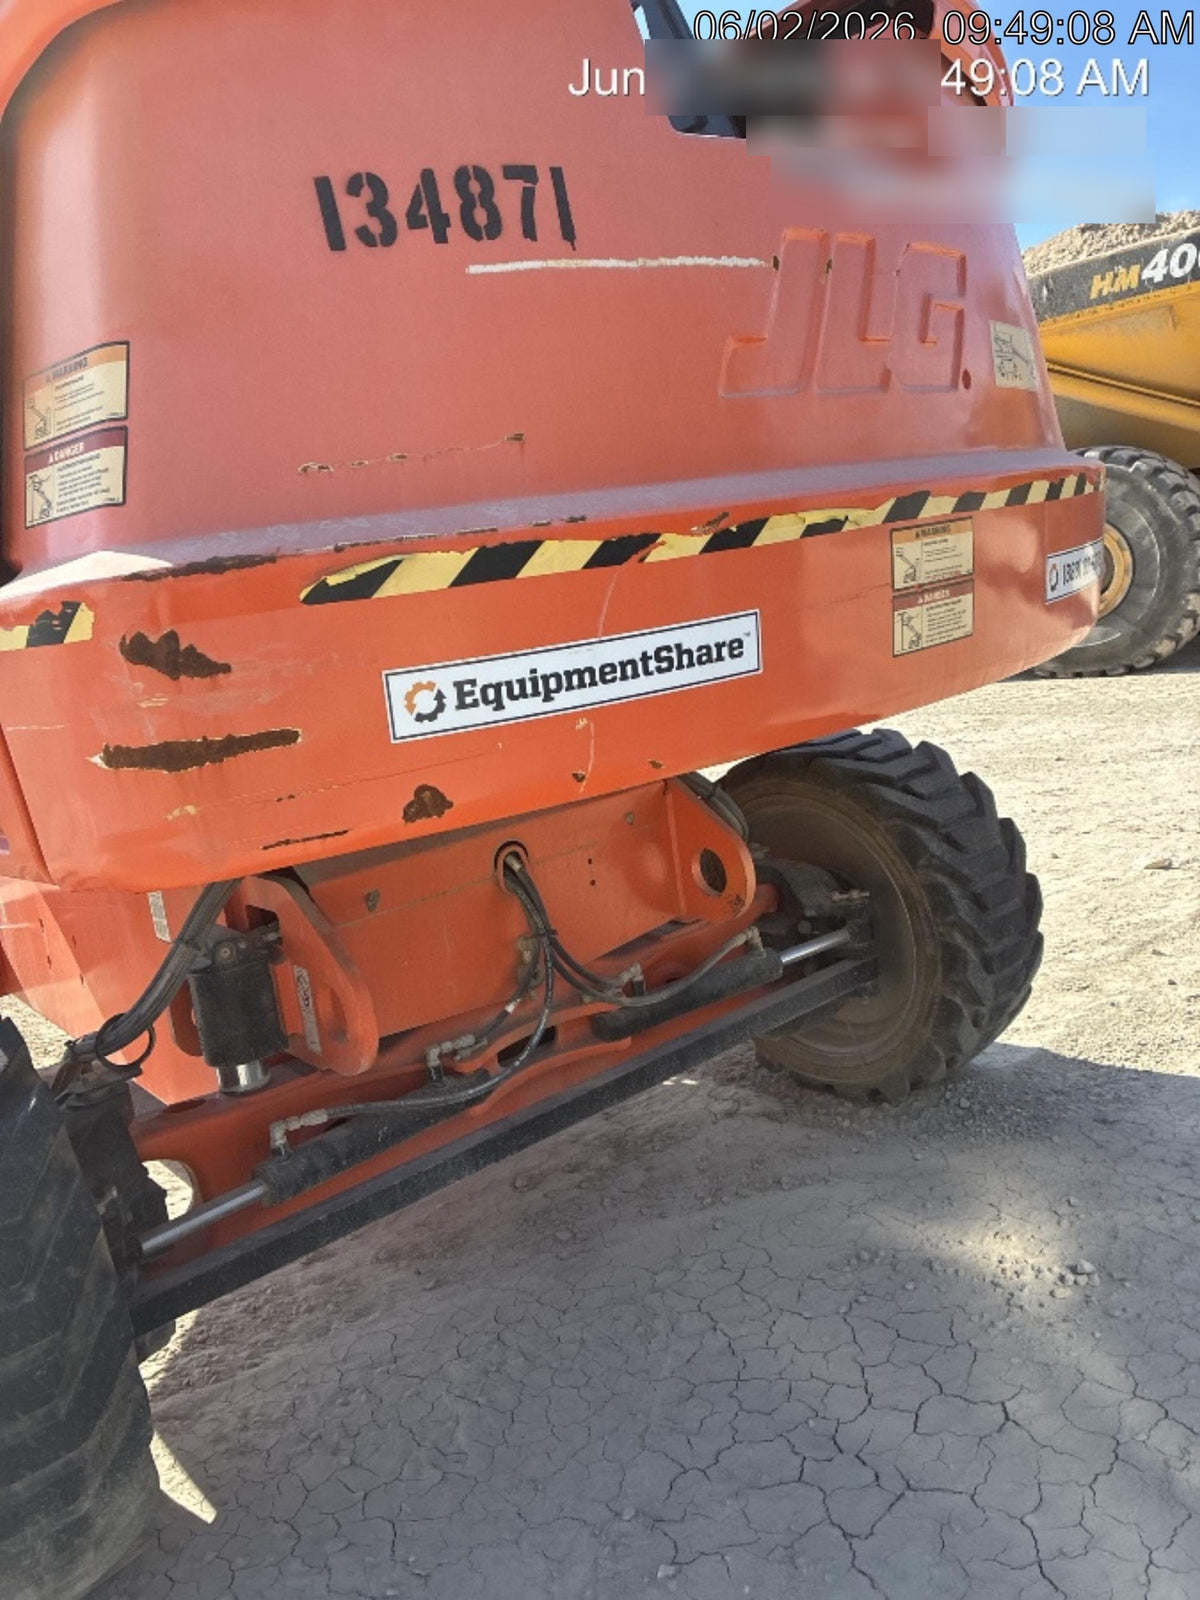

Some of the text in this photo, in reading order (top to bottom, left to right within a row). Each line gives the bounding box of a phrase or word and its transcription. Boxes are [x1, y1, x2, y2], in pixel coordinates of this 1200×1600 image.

[314, 165, 576, 250] 134871
[1090, 243, 1200, 299] HM40
[719, 227, 967, 398] JLG
[453, 637, 744, 711] EquipmentShare
